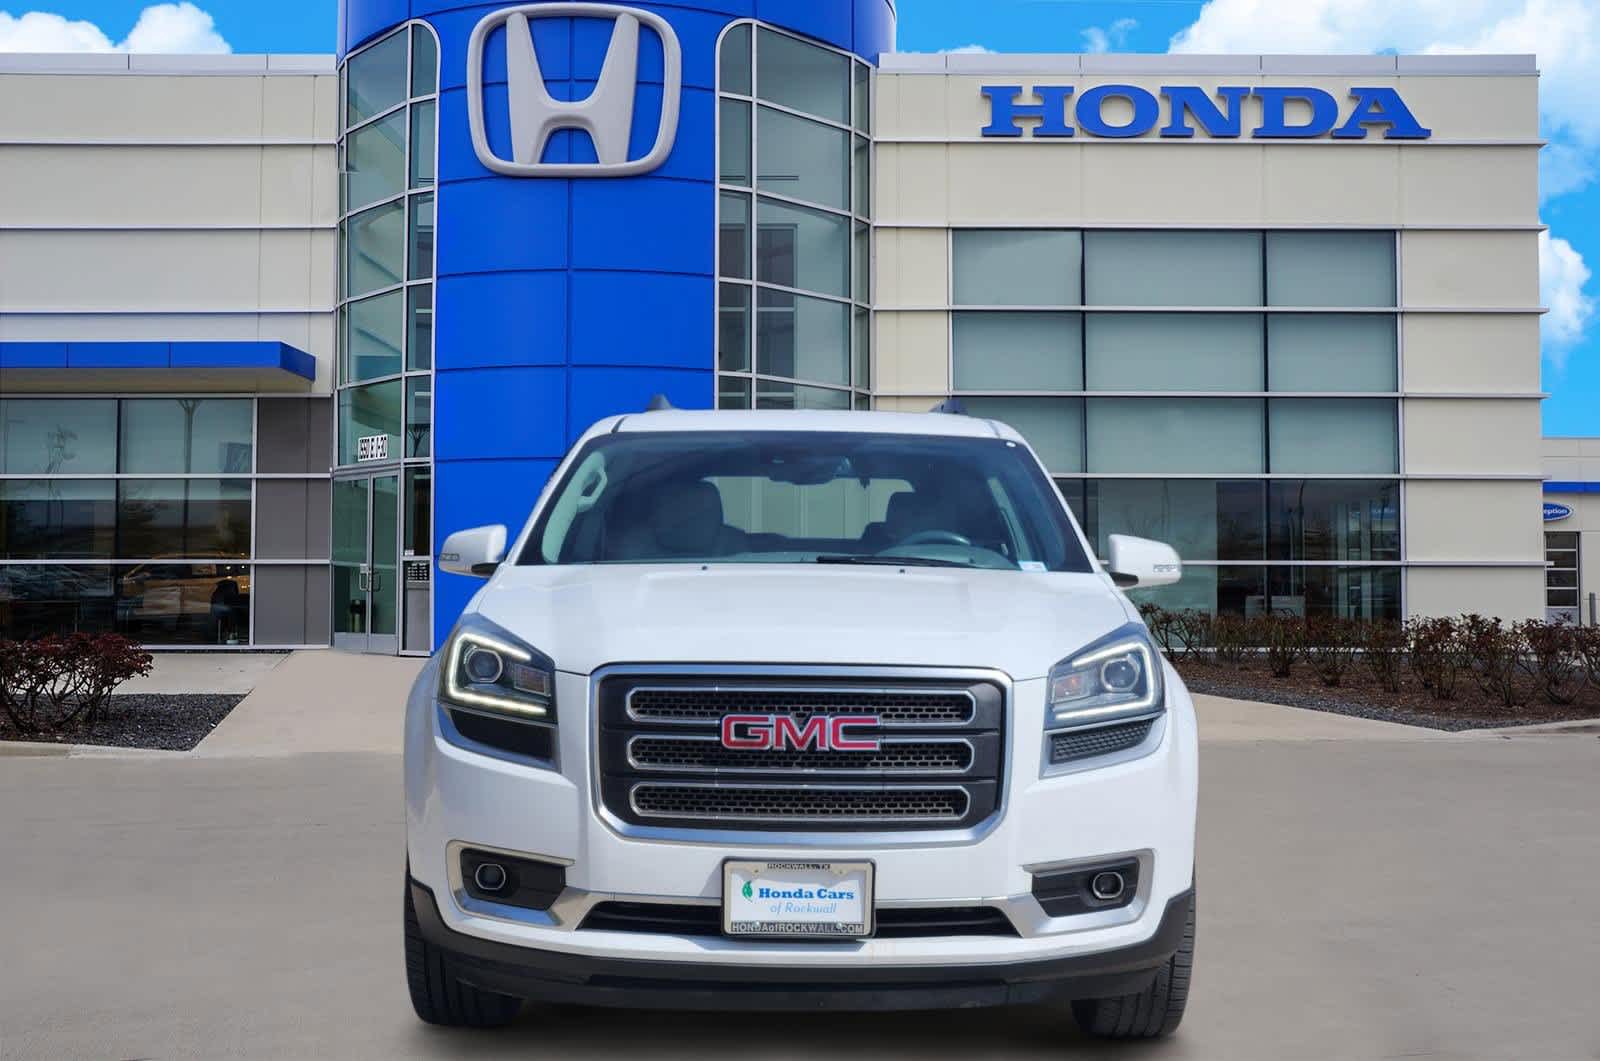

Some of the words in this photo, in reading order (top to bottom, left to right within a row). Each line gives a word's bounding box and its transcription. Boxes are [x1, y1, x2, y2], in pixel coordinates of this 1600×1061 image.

[981, 84, 1433, 140] HONDA
[721, 713, 881, 752] GMC
[758, 887, 814, 899] Honda
[816, 888, 855, 900] Cars
[770, 902, 782, 915] of
[784, 902, 837, 914] Rockwall
